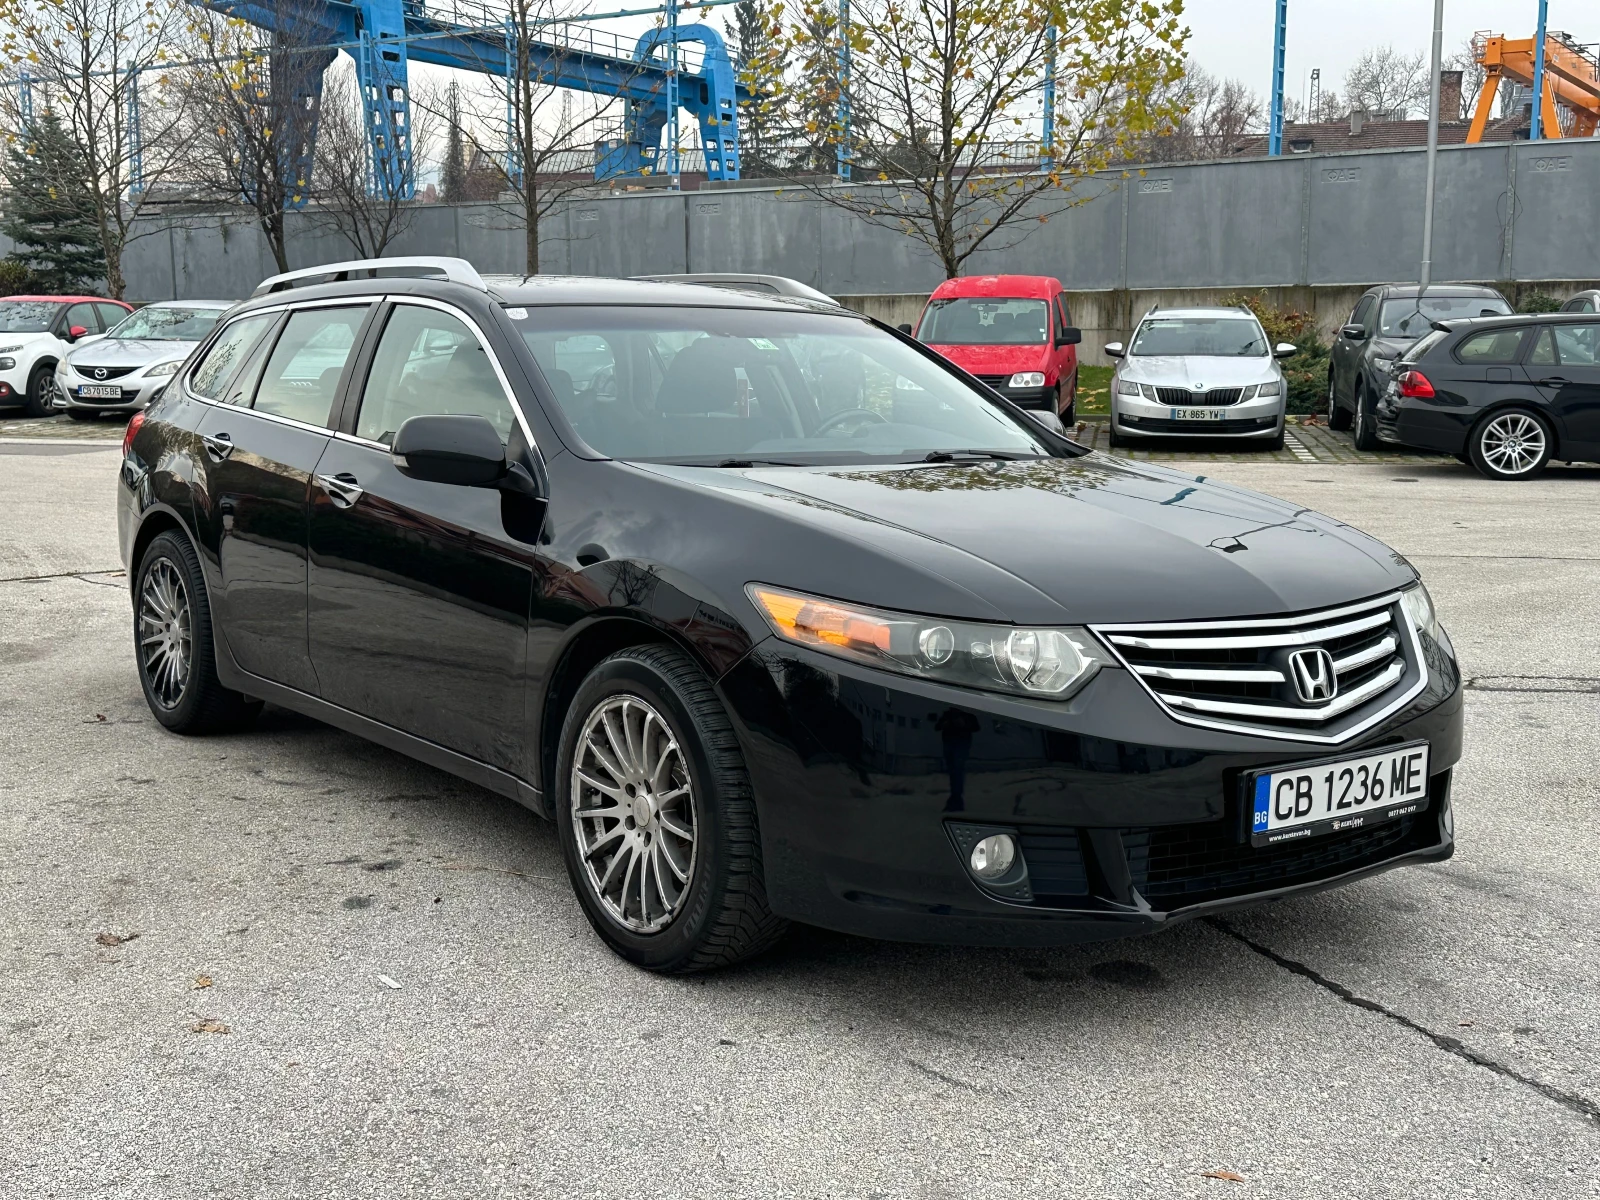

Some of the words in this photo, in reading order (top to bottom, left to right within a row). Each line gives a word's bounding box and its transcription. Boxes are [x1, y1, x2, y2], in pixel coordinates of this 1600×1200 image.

[1274, 775, 1313, 821] CB
[1324, 760, 1385, 812] 1236
[1389, 752, 1423, 798] ME
[1254, 811, 1268, 825] BG
